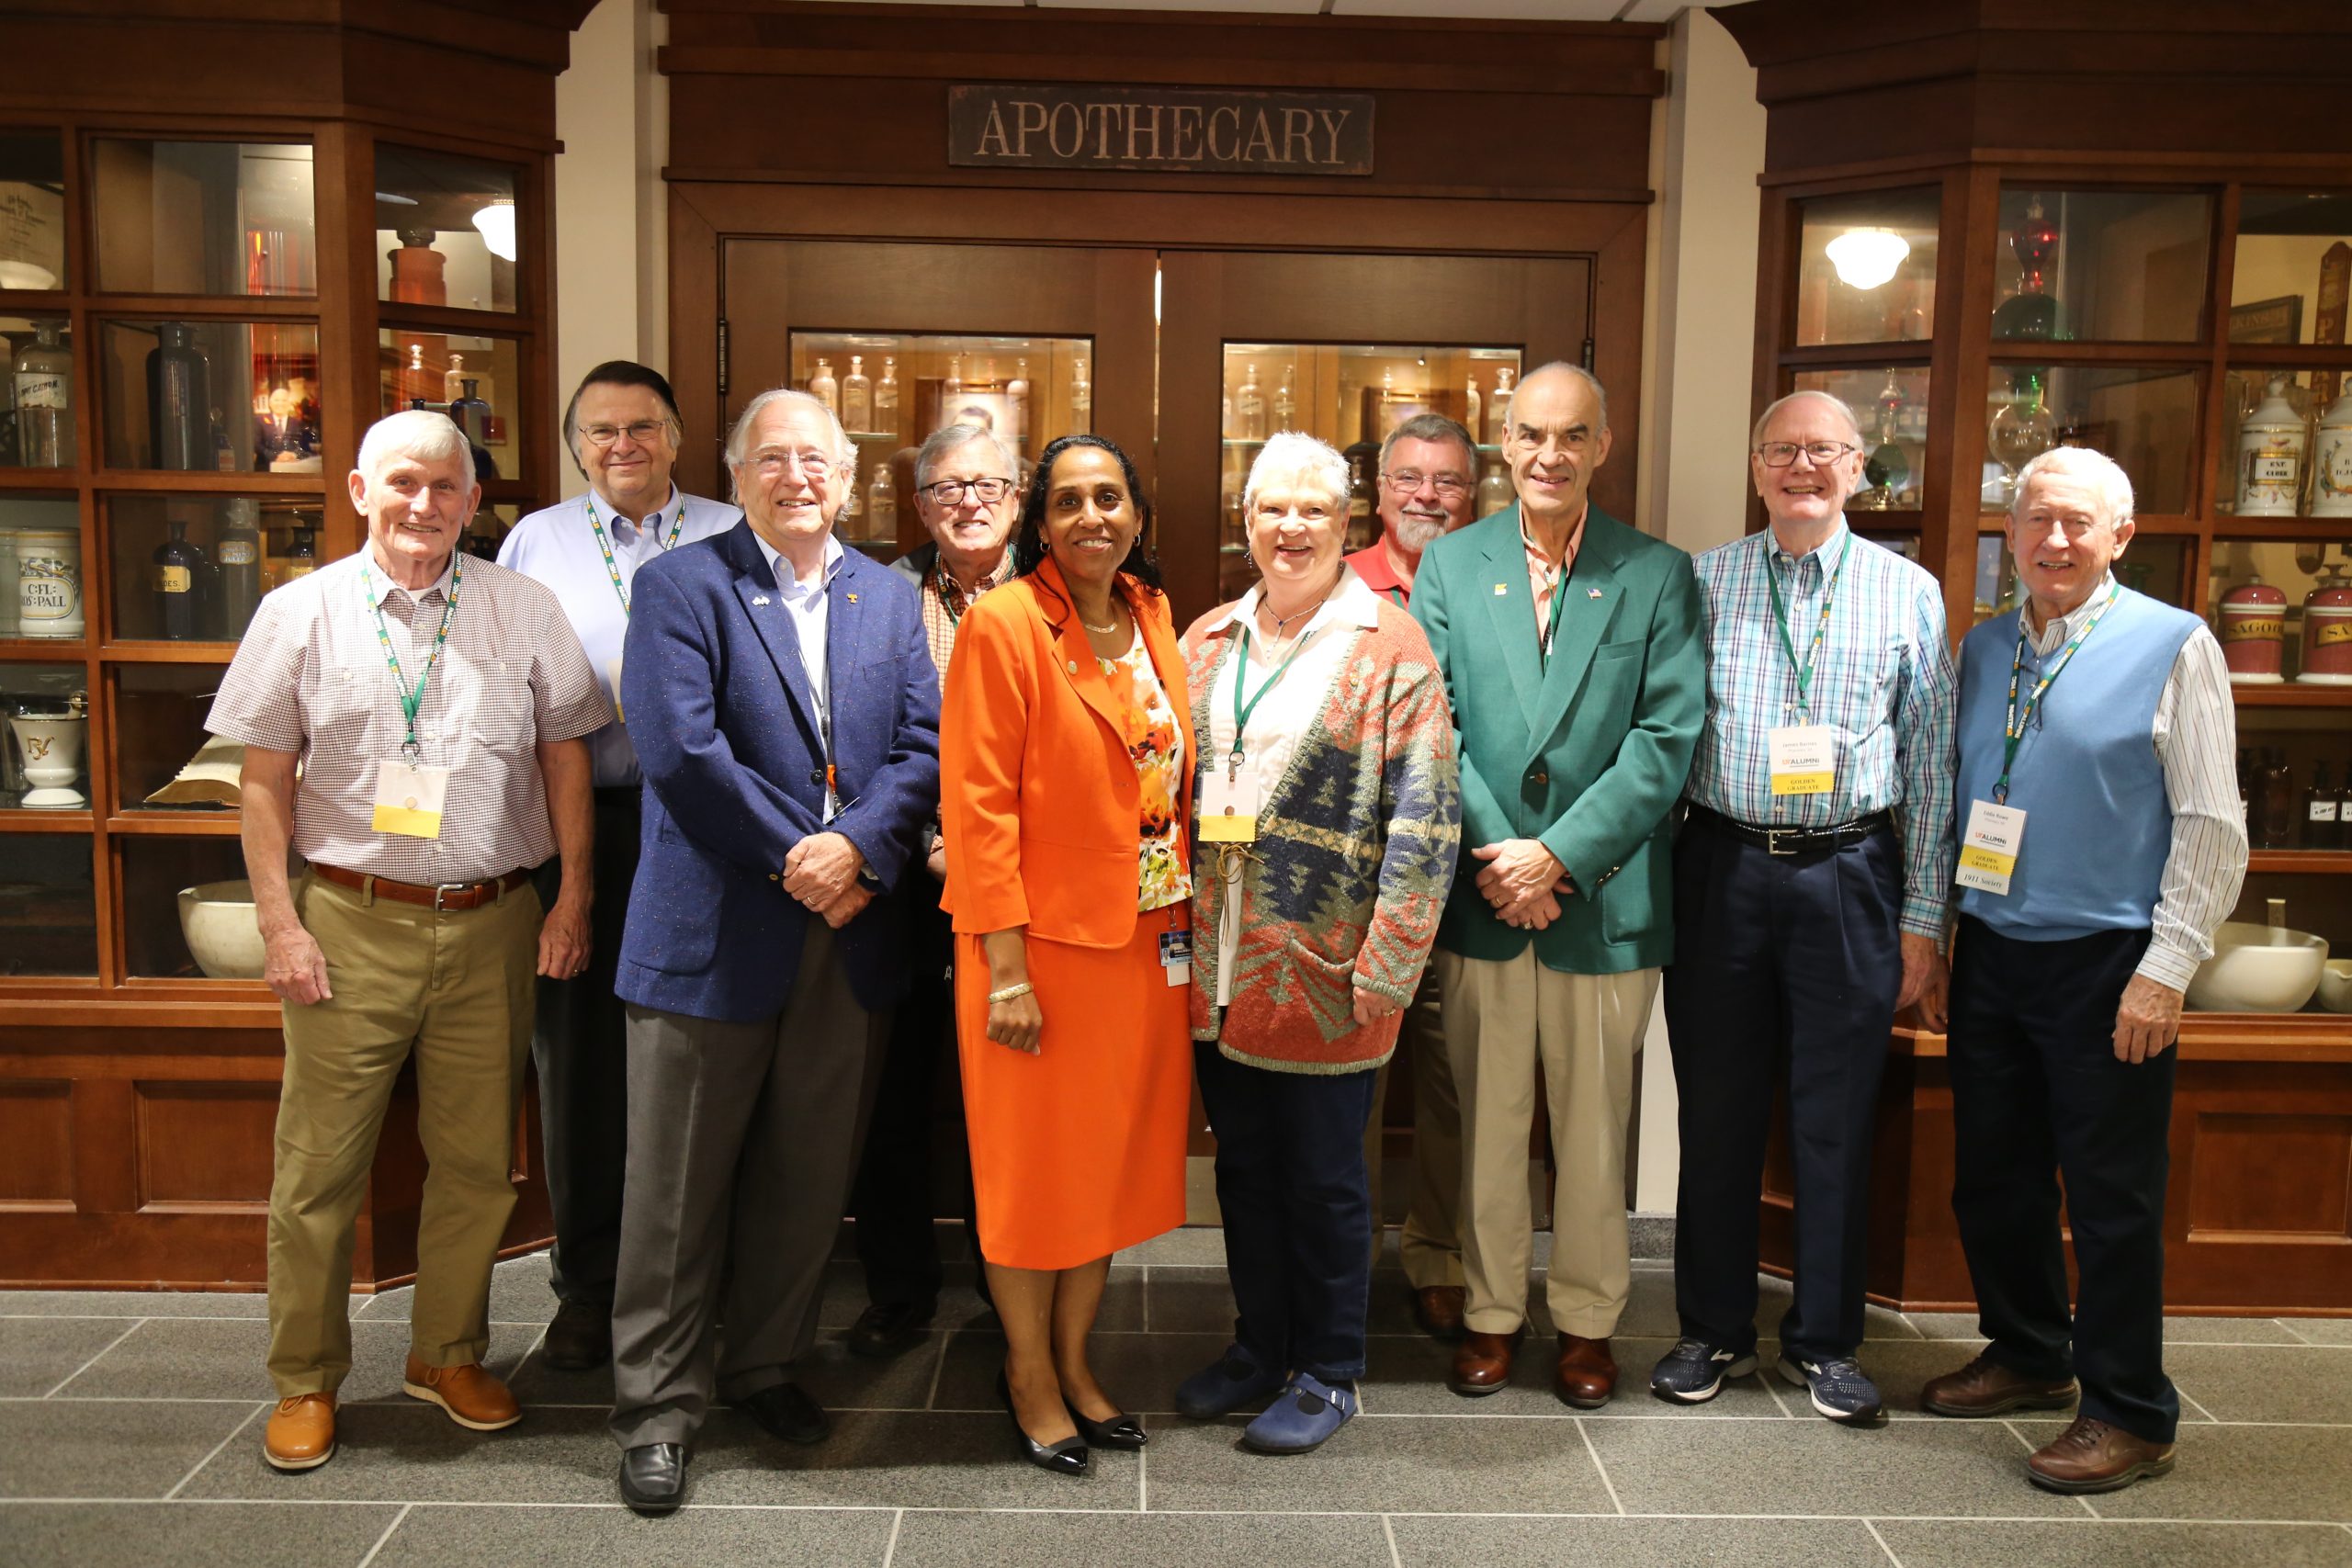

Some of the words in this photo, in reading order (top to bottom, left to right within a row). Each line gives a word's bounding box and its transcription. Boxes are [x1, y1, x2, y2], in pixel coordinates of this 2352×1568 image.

[974, 98, 1352, 165] APOTHECARY
[1975, 854, 1998, 863] GOLDEN
[1971, 861, 1999, 872] GRADUATE
[1964, 874, 1979, 883] 1911
[1981, 877, 2003, 889] Society
